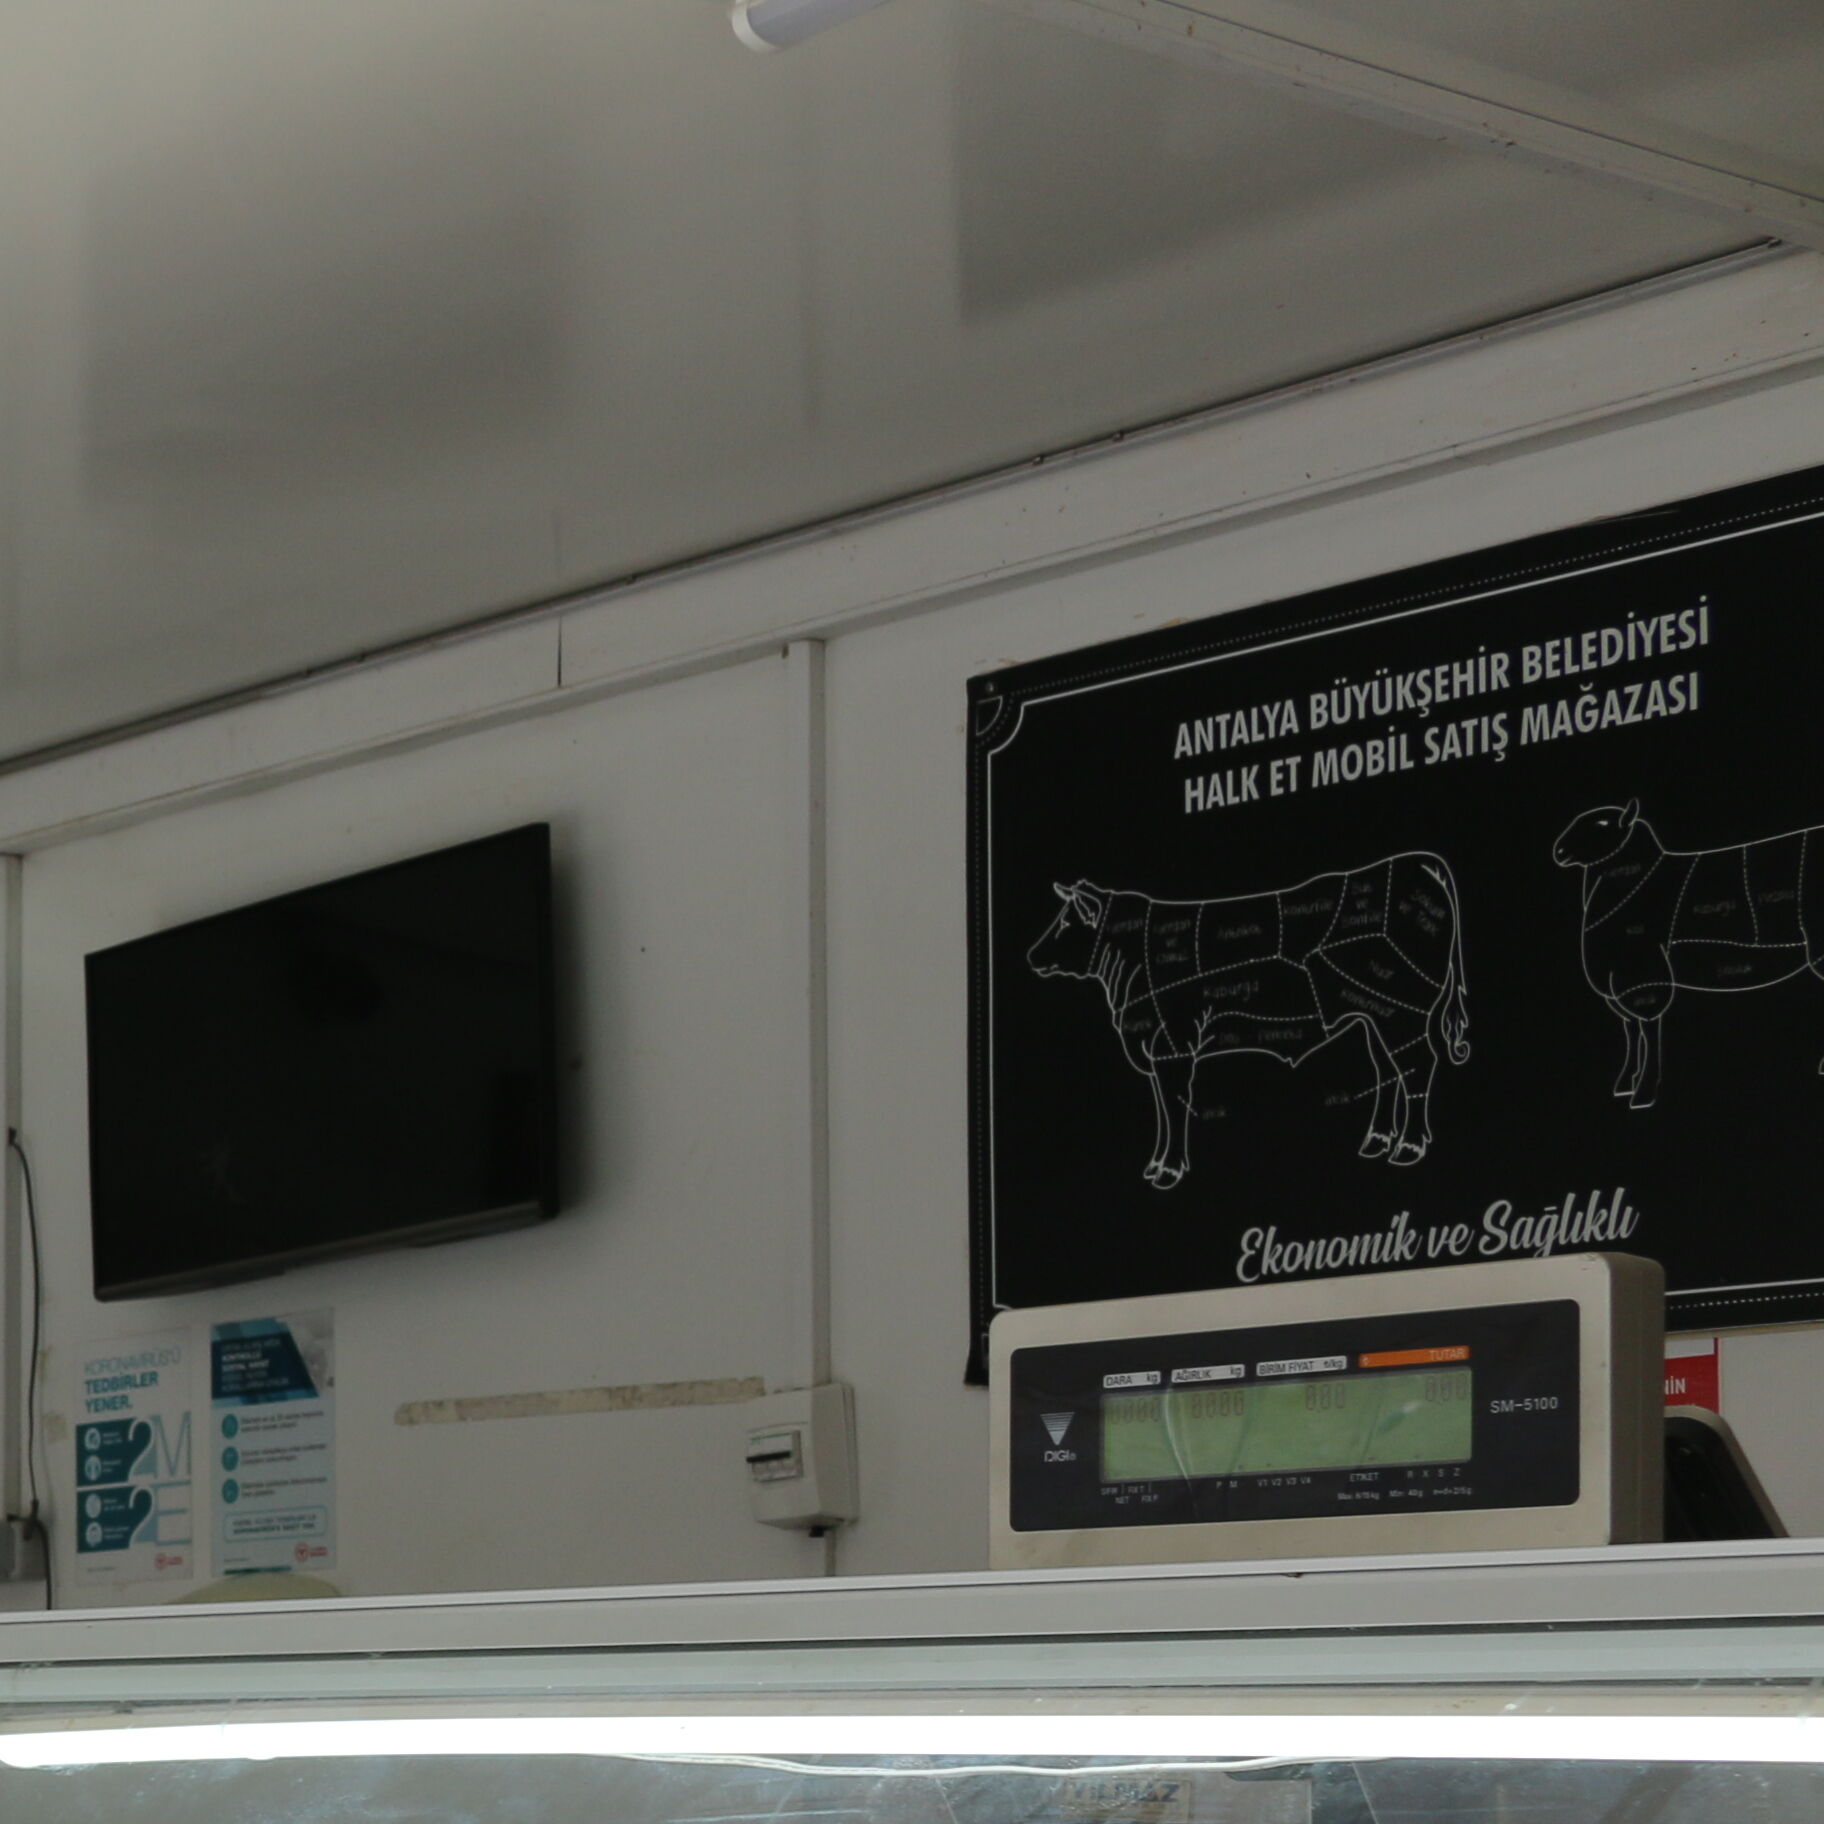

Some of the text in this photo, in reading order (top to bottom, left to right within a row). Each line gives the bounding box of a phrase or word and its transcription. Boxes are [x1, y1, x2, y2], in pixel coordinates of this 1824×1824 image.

[1174, 595, 1708, 758] ANTALYA BÜYÜKŞEHİR BELEDİYESİ
[1185, 671, 1698, 813] HALK ET MOBİL SATIŞ MAĞAZASI
[1237, 1212, 1421, 1283] Ekonomik
[1428, 1224, 1472, 1258] ve
[1429, 1347, 1466, 1361] TUTAR
[1174, 1366, 1242, 1381] AĞIRLIK kg
[1259, 1361, 1286, 1375] BİRİM
[1288, 1360, 1314, 1372] FİYAT
[1106, 1372, 1158, 1386] DARA kg
[1489, 1396, 1560, 1414] SM-5100
[1044, 1449, 1070, 1462] DIGI
